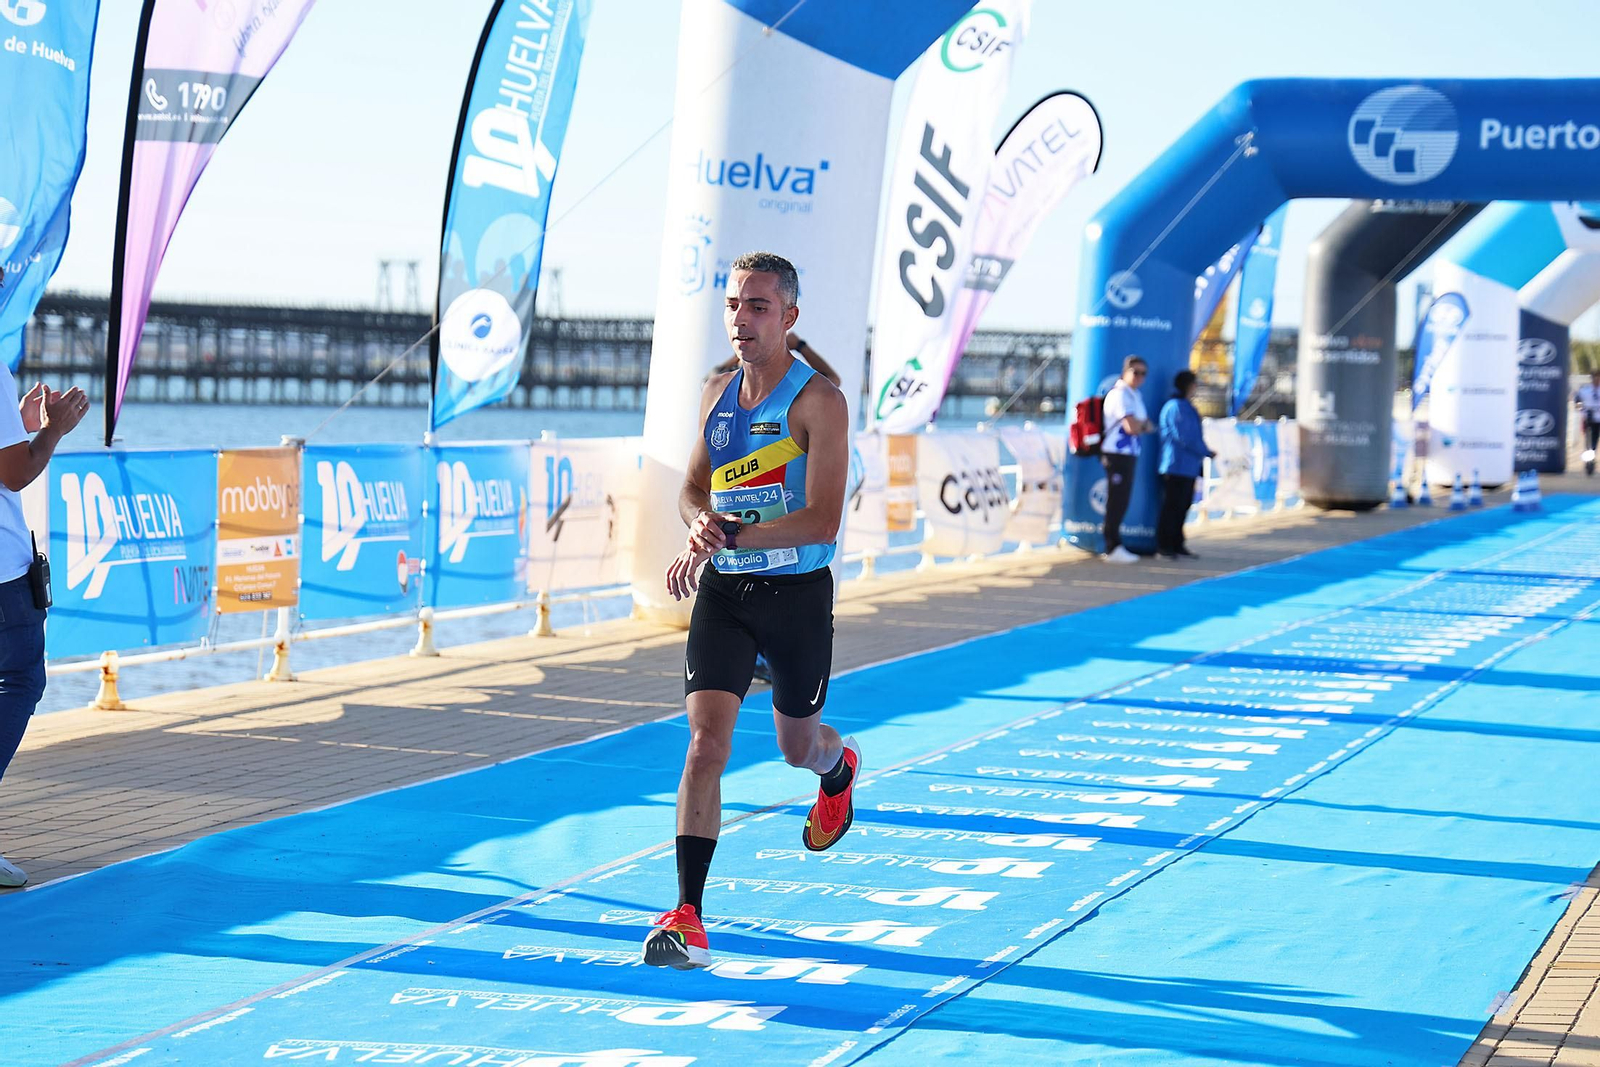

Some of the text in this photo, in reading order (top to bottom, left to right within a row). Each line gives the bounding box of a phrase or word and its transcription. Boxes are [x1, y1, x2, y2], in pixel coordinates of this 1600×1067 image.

[4, 35, 76, 72] de Huelva
[956, 26, 1011, 57] CSIF
[757, 197, 813, 214] original
[898, 120, 971, 318] CSIF
[724, 458, 760, 482] CLUB
[359, 480, 410, 522] HUELVA
[472, 479, 515, 518] HUELVA
[109, 492, 185, 541] HUELVA
[928, 784, 1085, 800] HUELVA
[878, 804, 1038, 820] HUELVA
[848, 828, 993, 842] HUELV
[755, 851, 940, 869] HUELVA
[599, 913, 811, 935] HUEVA
[391, 993, 633, 1017] HUELVA
[263, 1044, 529, 1067] HUELVA
